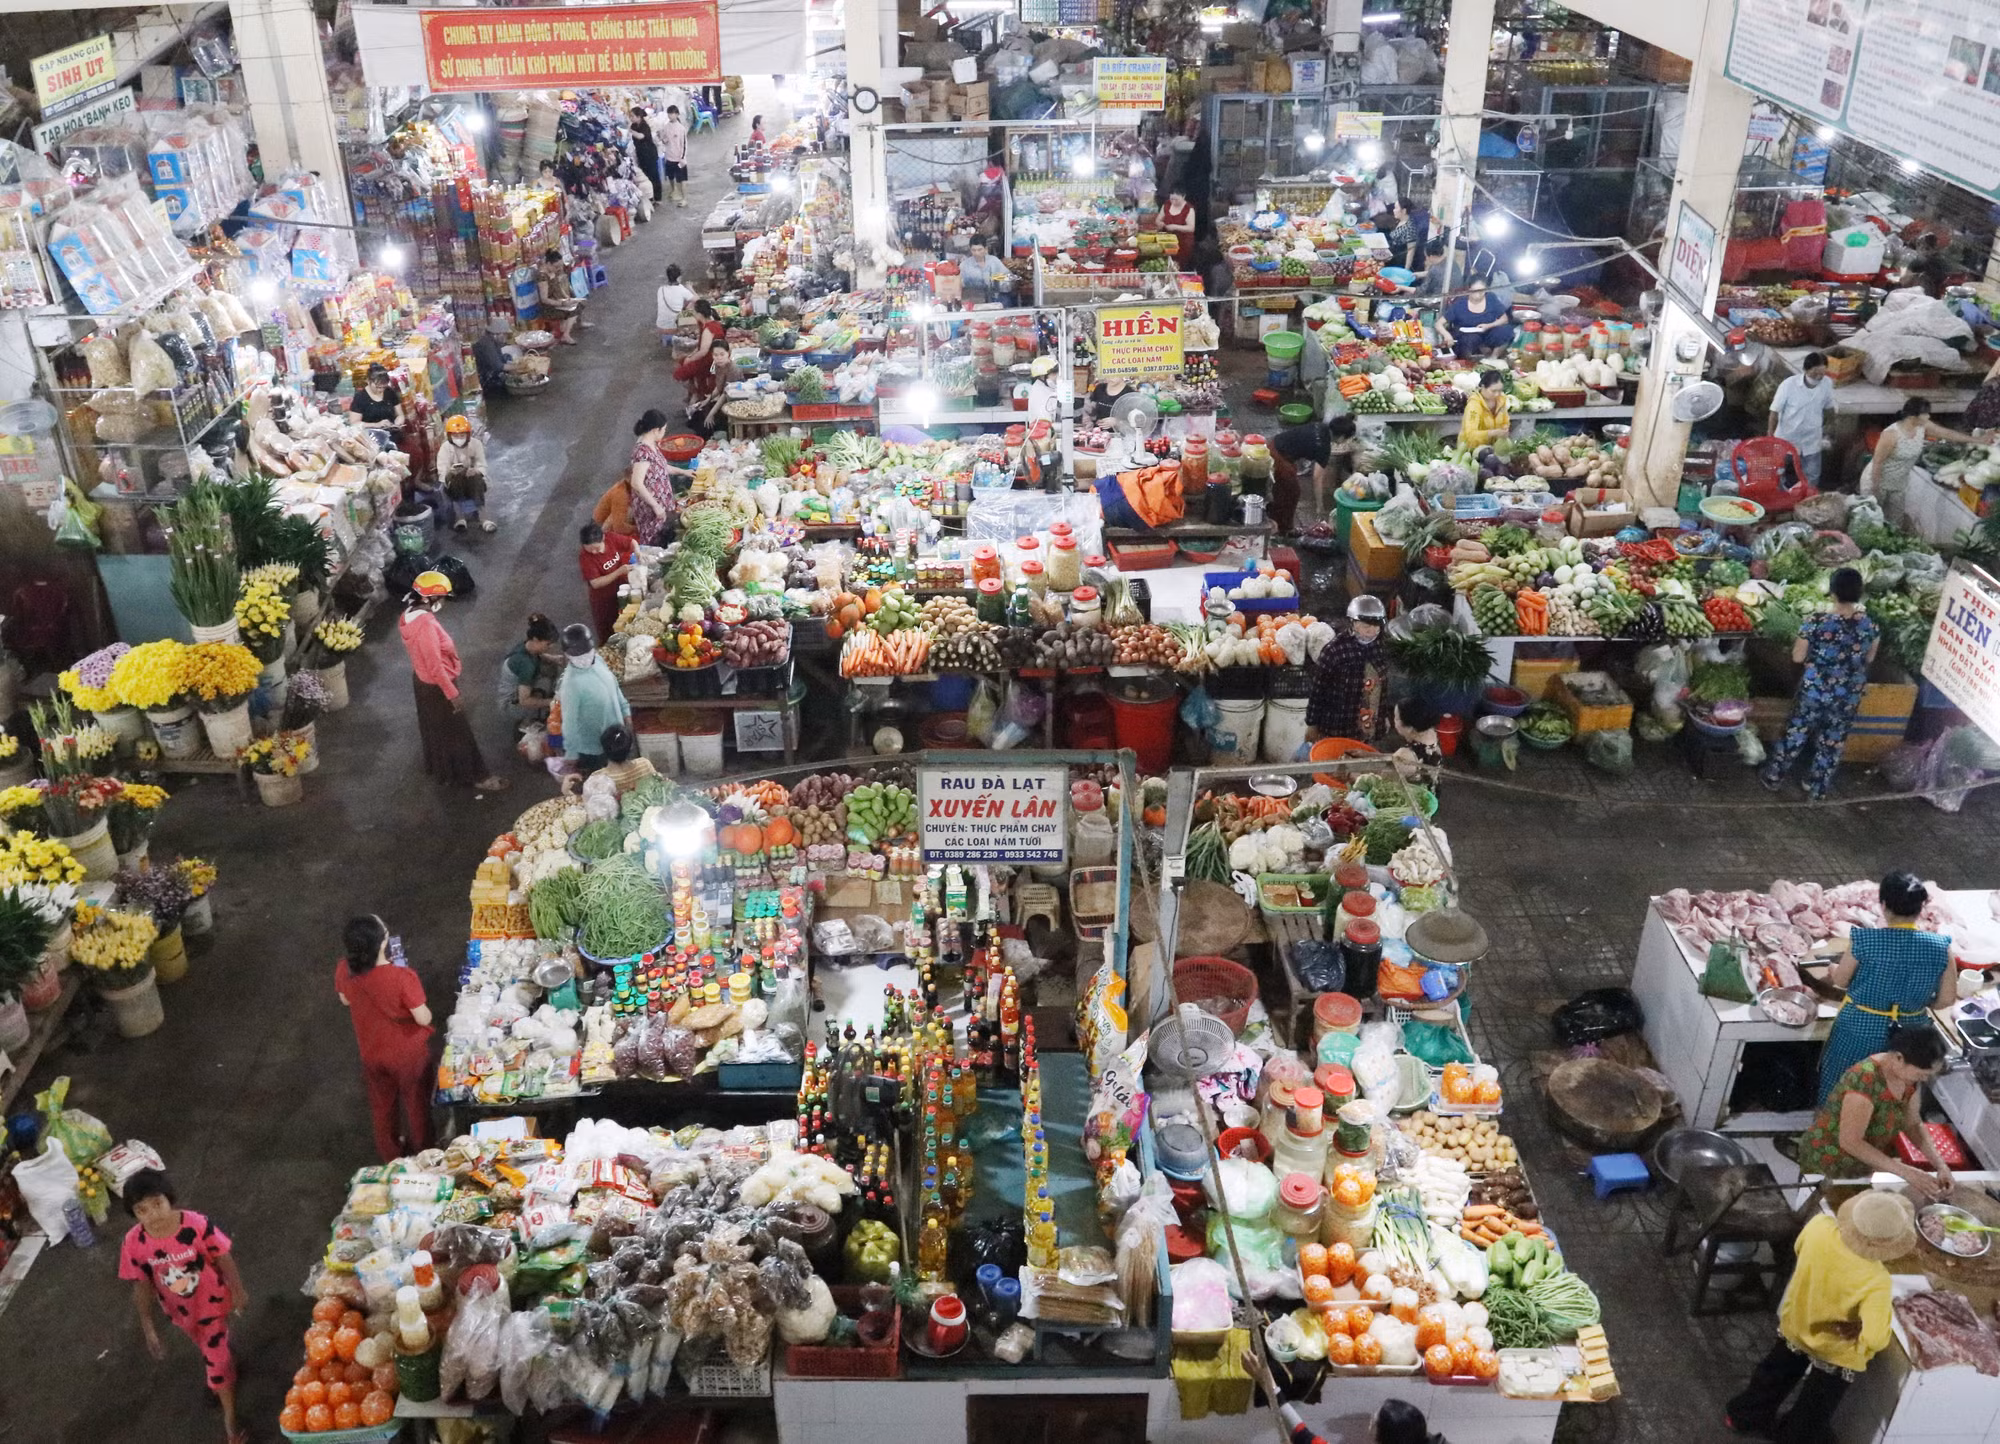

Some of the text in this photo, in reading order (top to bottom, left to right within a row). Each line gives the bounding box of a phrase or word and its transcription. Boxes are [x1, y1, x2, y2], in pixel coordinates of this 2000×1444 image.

[443, 12, 699, 46] CHUNG TAY HÀNH ĐỘNG PHÒNG, CHỐNG RÁC THẢI NHỰA
[56, 50, 86, 66] NHANG
[440, 45, 708, 82] SỬ DỤNG MỘT LẦN KHÓ PHÂN HỦY ĐỂ BẢO VỆ MÔI TRƯỜNG
[47, 65, 83, 93] SINH
[1102, 311, 1179, 337] HIỀN
[1962, 588, 1996, 620] THỊT
[1939, 620, 1964, 646] BÁN
[1945, 597, 1992, 649] LIÊN
[941, 774, 1046, 792] RAU ĐÀ LẠT
[928, 793, 1057, 818] XUYẾN LÂN
[925, 820, 1057, 835] CHUYÊN: THỰC PHẨM CHAY
[944, 836, 964, 847] CÁC
[967, 837, 990, 848] LOẠI
[994, 834, 1016, 847] NẤM
[944, 850, 964, 859] 0389
[966, 850, 981, 859] 286
[983, 850, 998, 859] 230
[1004, 850, 1024, 859] 0933
[1026, 850, 1042, 859] 542
[1043, 850, 1058, 859] 746
[171, 1248, 196, 1262] Luck
